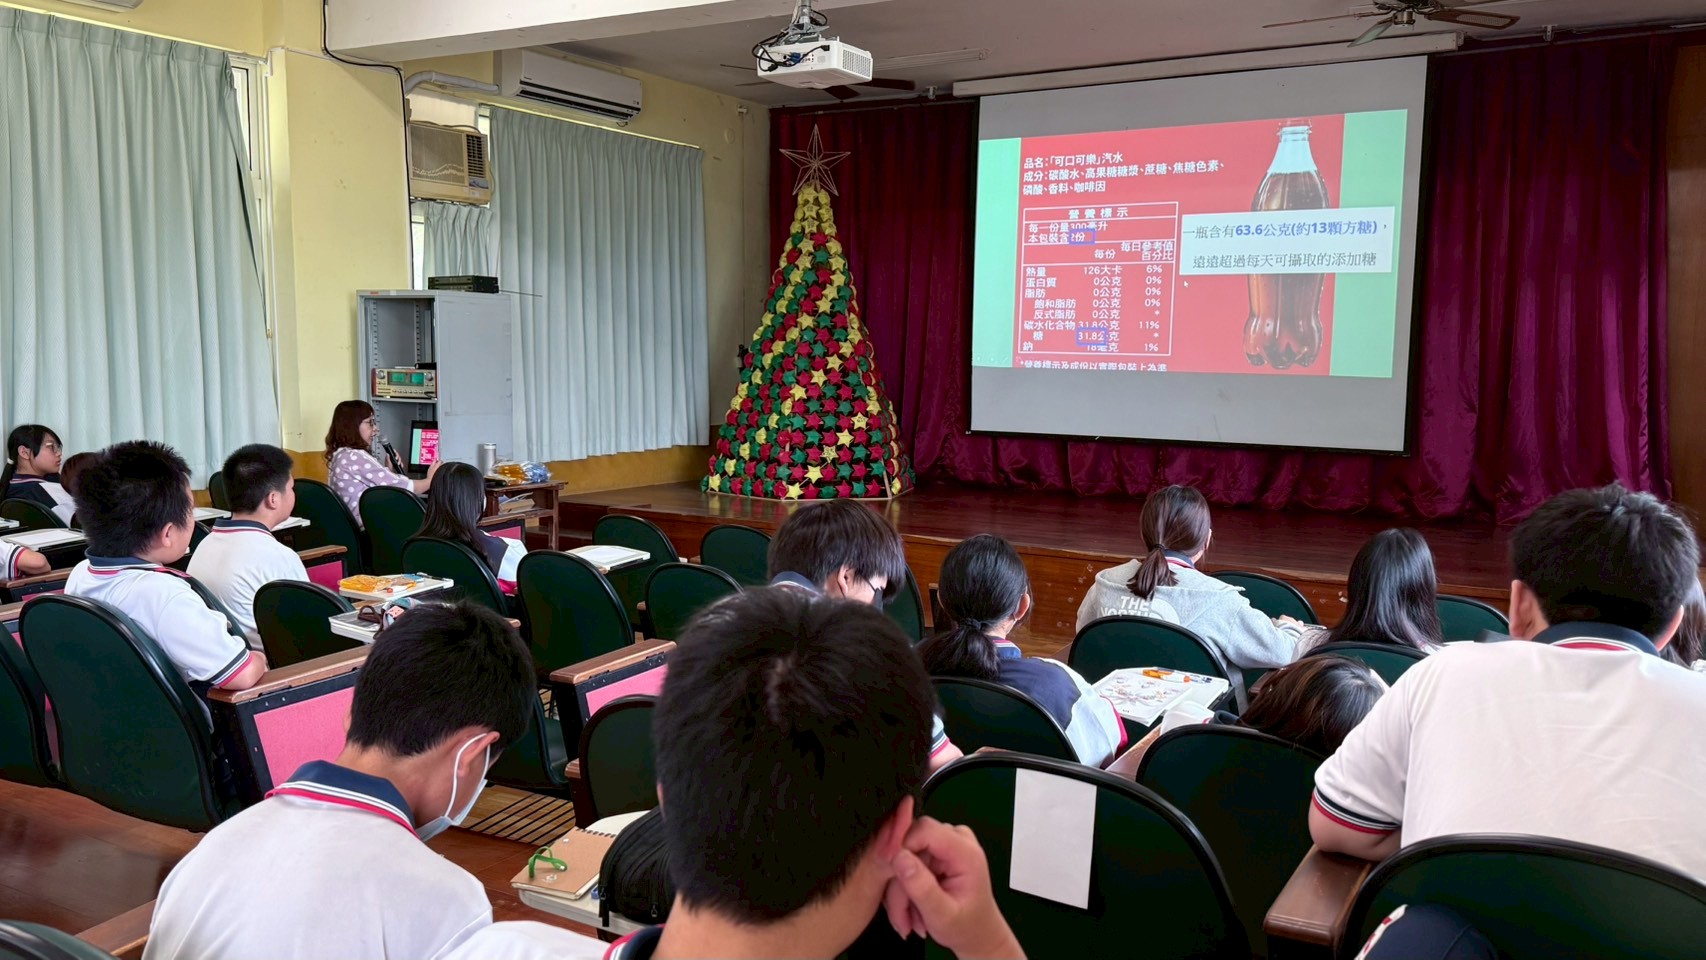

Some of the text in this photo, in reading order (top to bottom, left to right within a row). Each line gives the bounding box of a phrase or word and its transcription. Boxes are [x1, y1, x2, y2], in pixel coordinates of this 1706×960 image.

[1068, 208, 1128, 219] 營養標示
[1094, 250, 1116, 259] 每份
[1193, 252, 1376, 269] 遠遠超過每天可攝取的添加糖
[1026, 265, 1162, 277] 熱量 126大卡 6%
[1026, 276, 1162, 288] 蛋白質 0公克 0%
[1025, 287, 1161, 298] 脂肪 0公克 0%
[1034, 298, 1160, 309] 飽和脂肪 0公克 0%
[1034, 309, 1120, 319] 反式脂肪 0公克
[1024, 320, 1076, 330] 碳水化合物
[1139, 321, 1159, 329] 11%
[1033, 331, 1044, 341] 糖
[1120, 596, 1150, 612] THE
